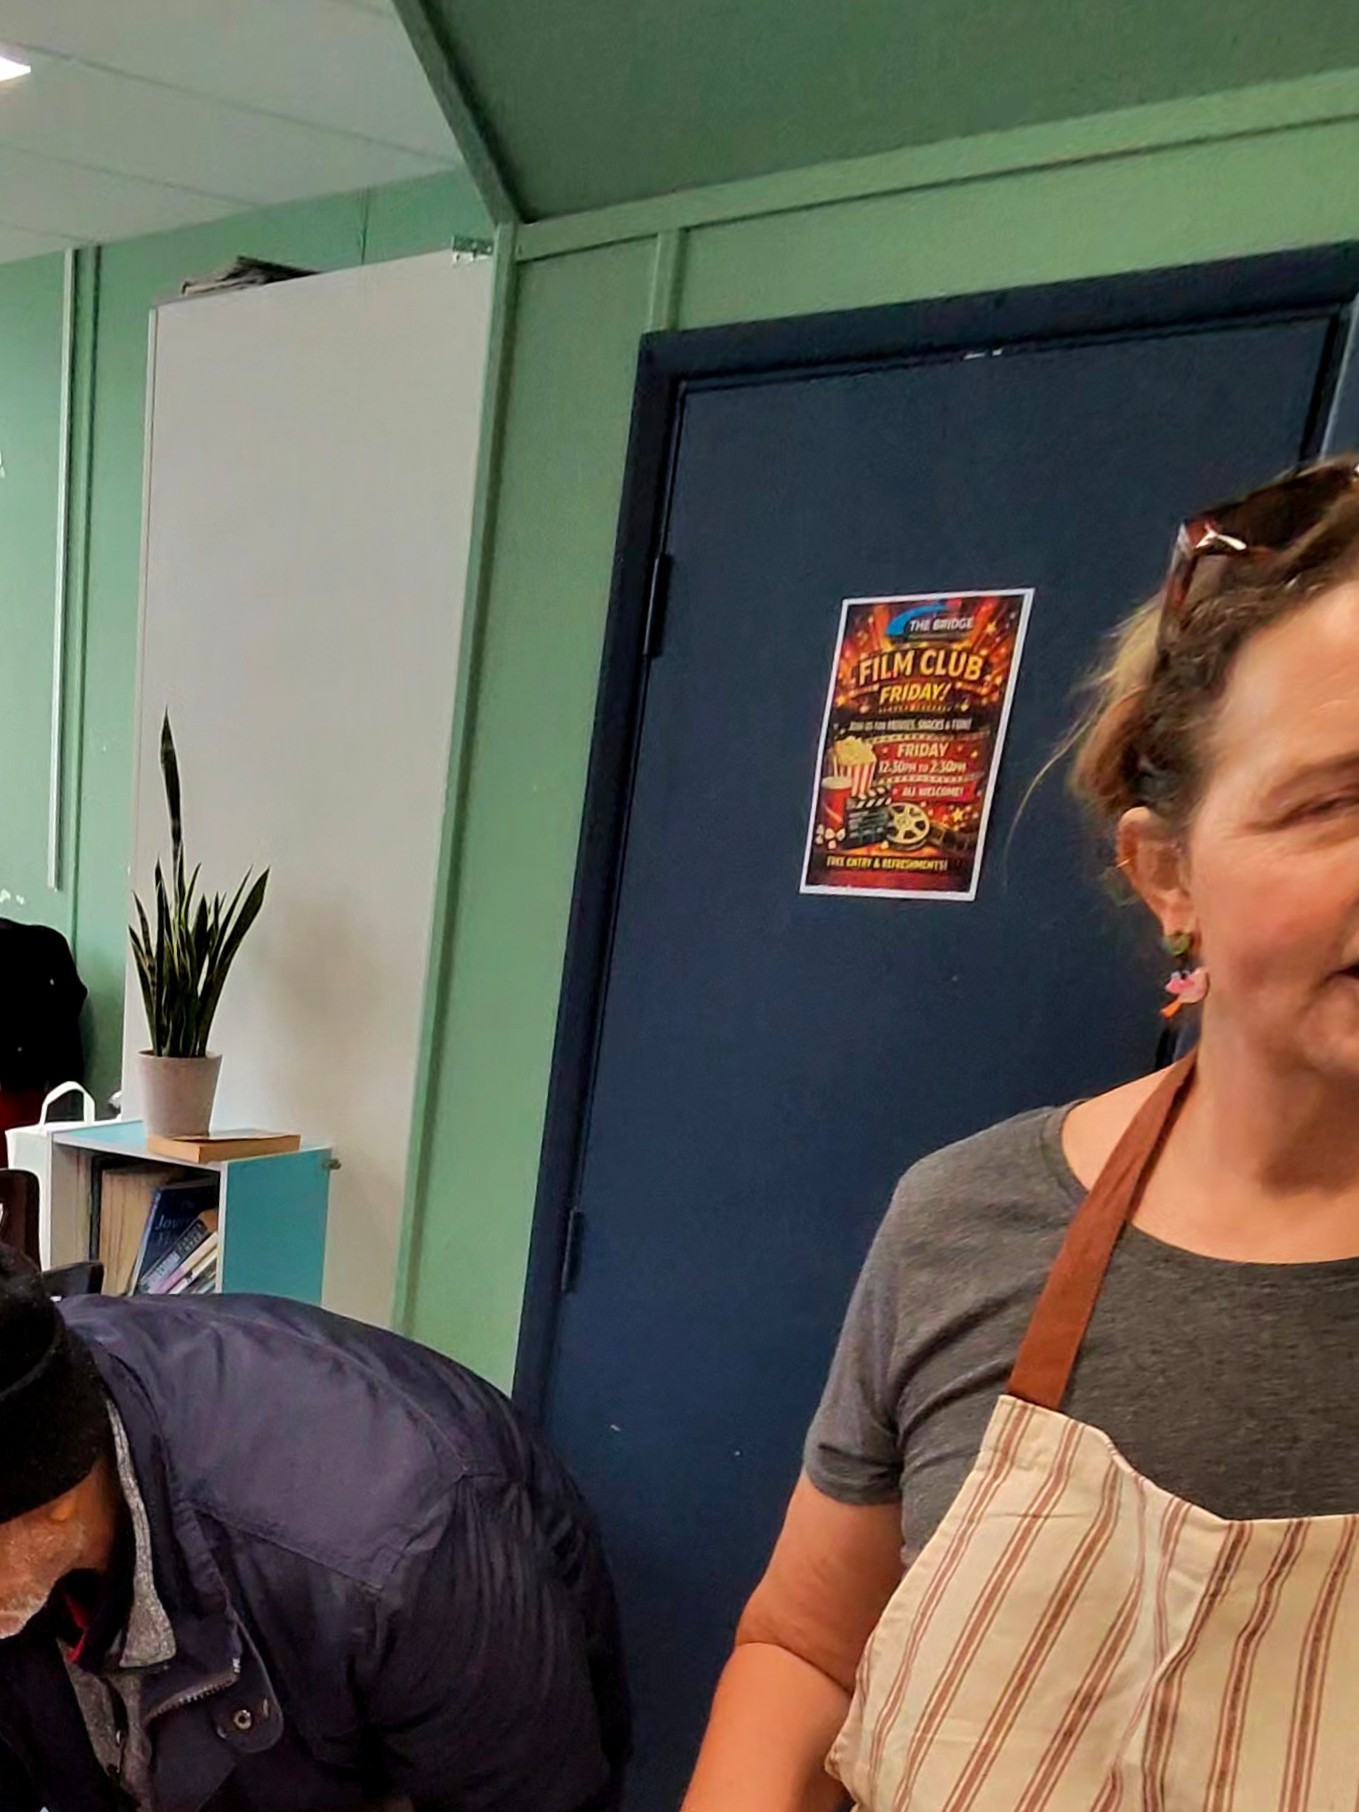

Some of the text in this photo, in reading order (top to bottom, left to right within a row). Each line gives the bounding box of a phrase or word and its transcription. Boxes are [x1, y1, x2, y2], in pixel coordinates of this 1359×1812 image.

[910, 616, 974, 632] THE BRIDGE
[859, 648, 983, 686] FILM CLUB
[879, 683, 951, 705] FRIDAY!
[918, 719, 944, 731] SNACKS
[897, 742, 950, 758] FRIDAY
[902, 786, 964, 797] ALL WELCOME!
[827, 855, 948, 871] FREE ENTRY & REFRESHMENTS!
